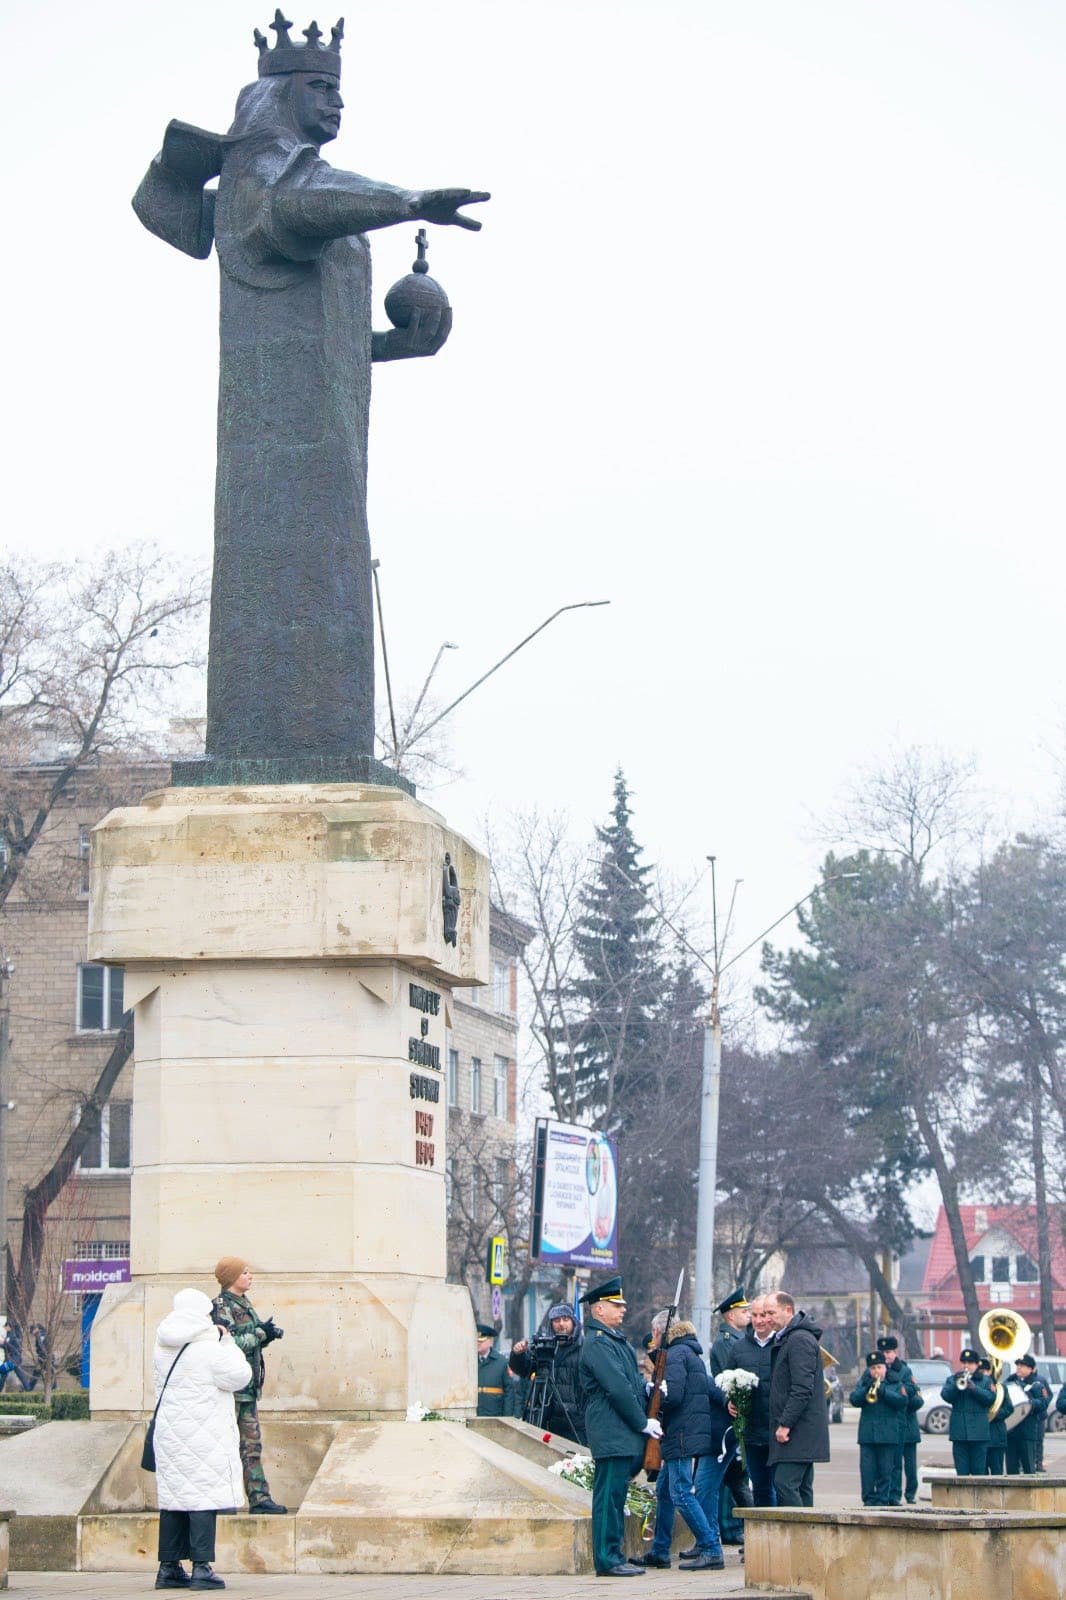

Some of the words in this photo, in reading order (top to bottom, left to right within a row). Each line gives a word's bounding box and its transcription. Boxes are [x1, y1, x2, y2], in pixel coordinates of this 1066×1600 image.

[415, 1110, 433, 1138] 1457
[415, 1140, 435, 1167] 1504
[72, 1269, 122, 1282] moldcell
